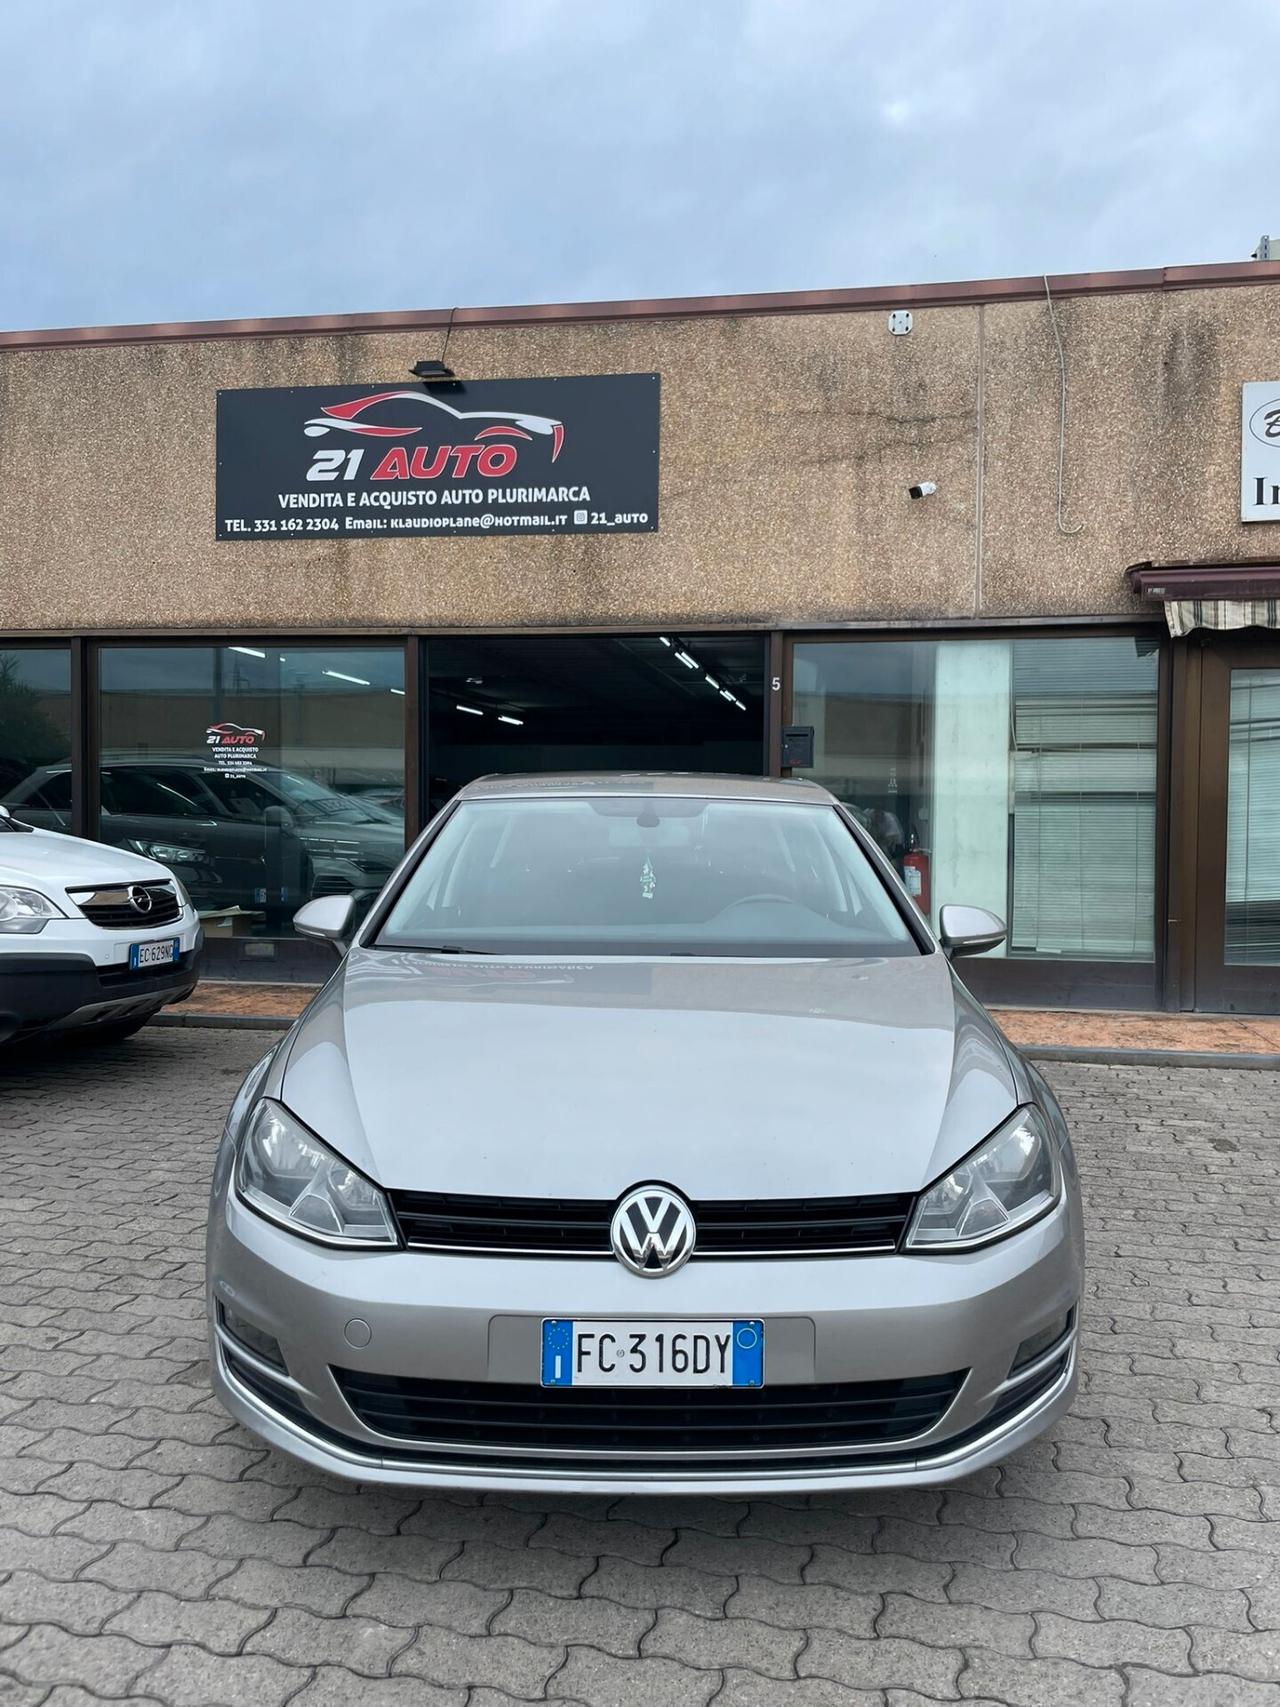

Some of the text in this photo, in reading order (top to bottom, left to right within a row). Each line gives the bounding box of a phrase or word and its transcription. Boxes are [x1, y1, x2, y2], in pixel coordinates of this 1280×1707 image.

[306, 444, 518, 482] 21 AUTO
[278, 486, 591, 509] VENDITA E ACQUISTO AUTO PLURIMARCA
[225, 519, 251, 532] TEL.
[254, 519, 278, 532] 331
[280, 518, 303, 531] 162
[306, 518, 339, 531] 2304
[771, 677, 781, 691] 5
[206, 735, 255, 744] 21 AUTO
[140, 948, 150, 963] EC
[577, 1333, 616, 1373] FC
[629, 1333, 731, 1374] 316DY
